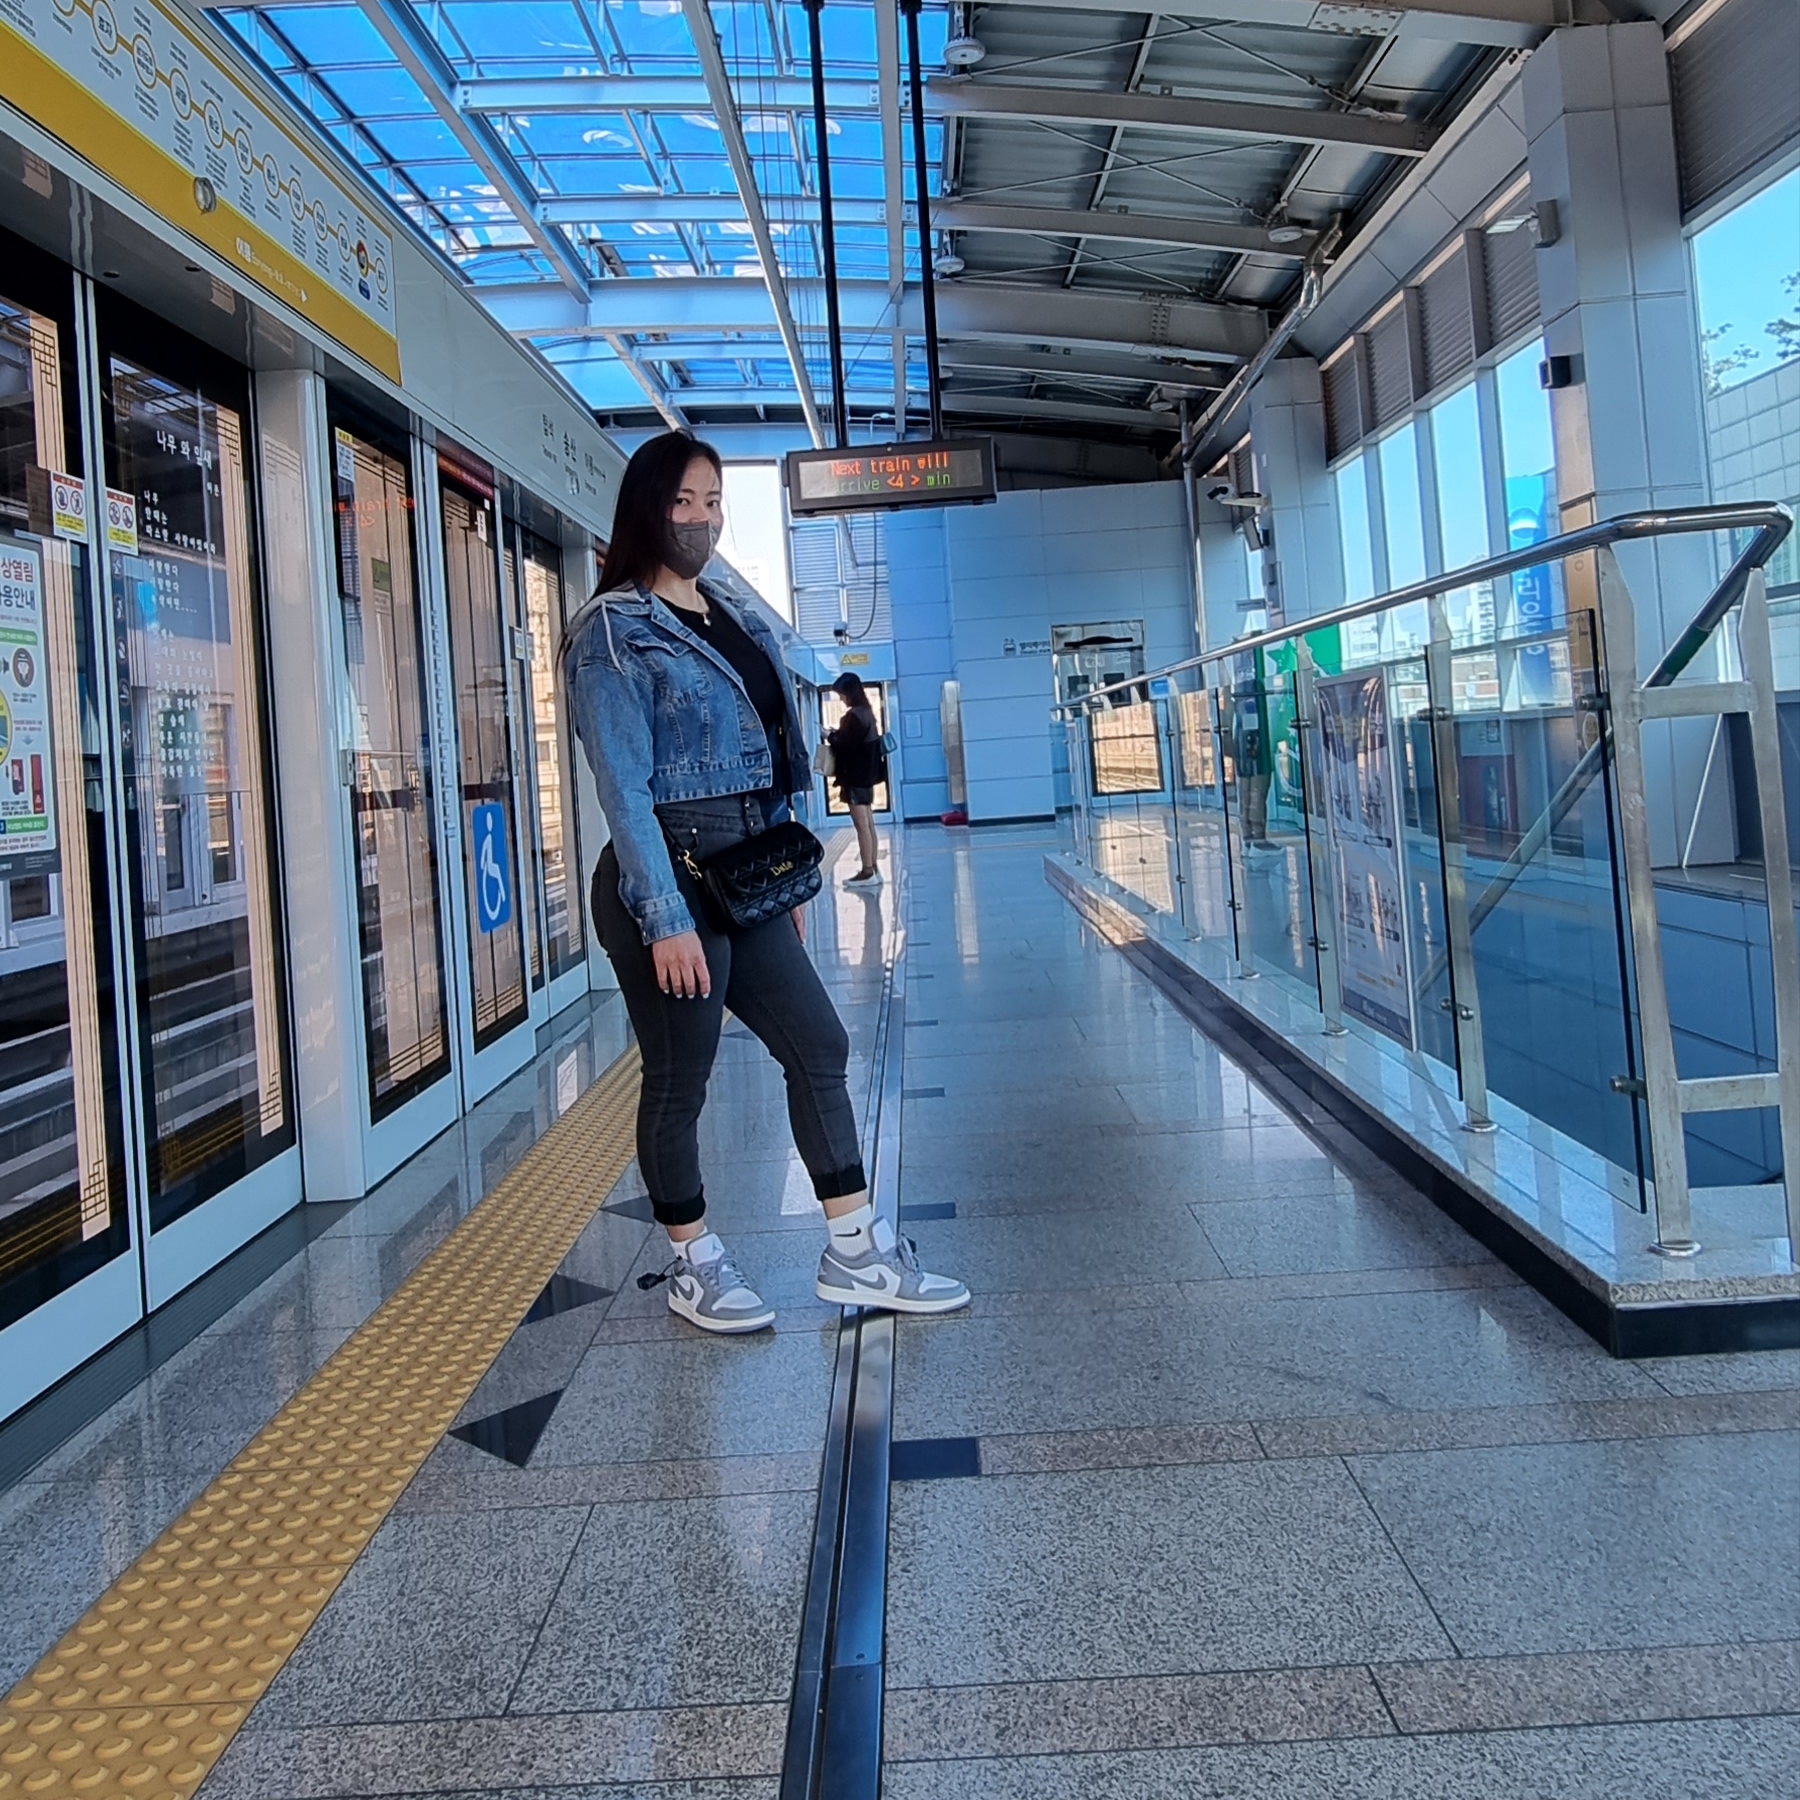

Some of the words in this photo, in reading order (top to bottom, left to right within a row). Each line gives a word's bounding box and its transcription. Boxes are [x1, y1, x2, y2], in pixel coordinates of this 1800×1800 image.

[157, 430, 177, 455] 나무
[180, 440, 190, 461] 와
[831, 460, 862, 476] Next
[870, 455, 910, 473] train
[917, 451, 949, 469] will
[836, 478, 880, 493] arrive
[927, 471, 951, 486] min
[144, 490, 159, 505] 나무
[1, 557, 34, 583] 상열림
[0, 585, 36, 611] 용안내
